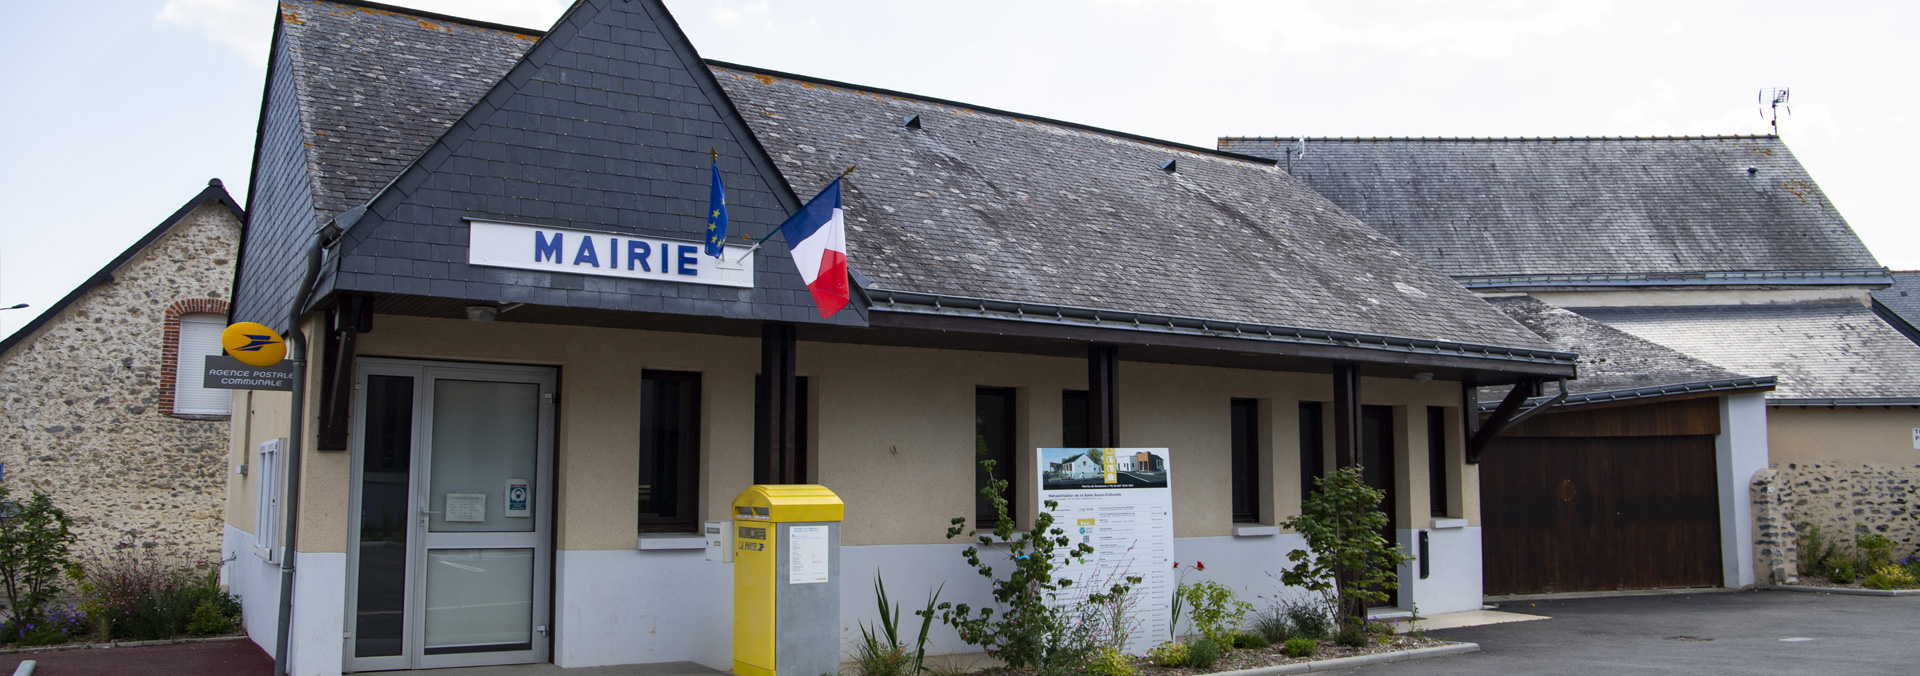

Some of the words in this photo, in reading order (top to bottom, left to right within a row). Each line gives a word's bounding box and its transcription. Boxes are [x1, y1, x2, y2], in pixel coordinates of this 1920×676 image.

[534, 230, 698, 276] MAIRIE
[209, 369, 250, 377] AGENCE
[253, 371, 294, 379] POSTALE
[221, 378, 283, 387] COMMUNALE
